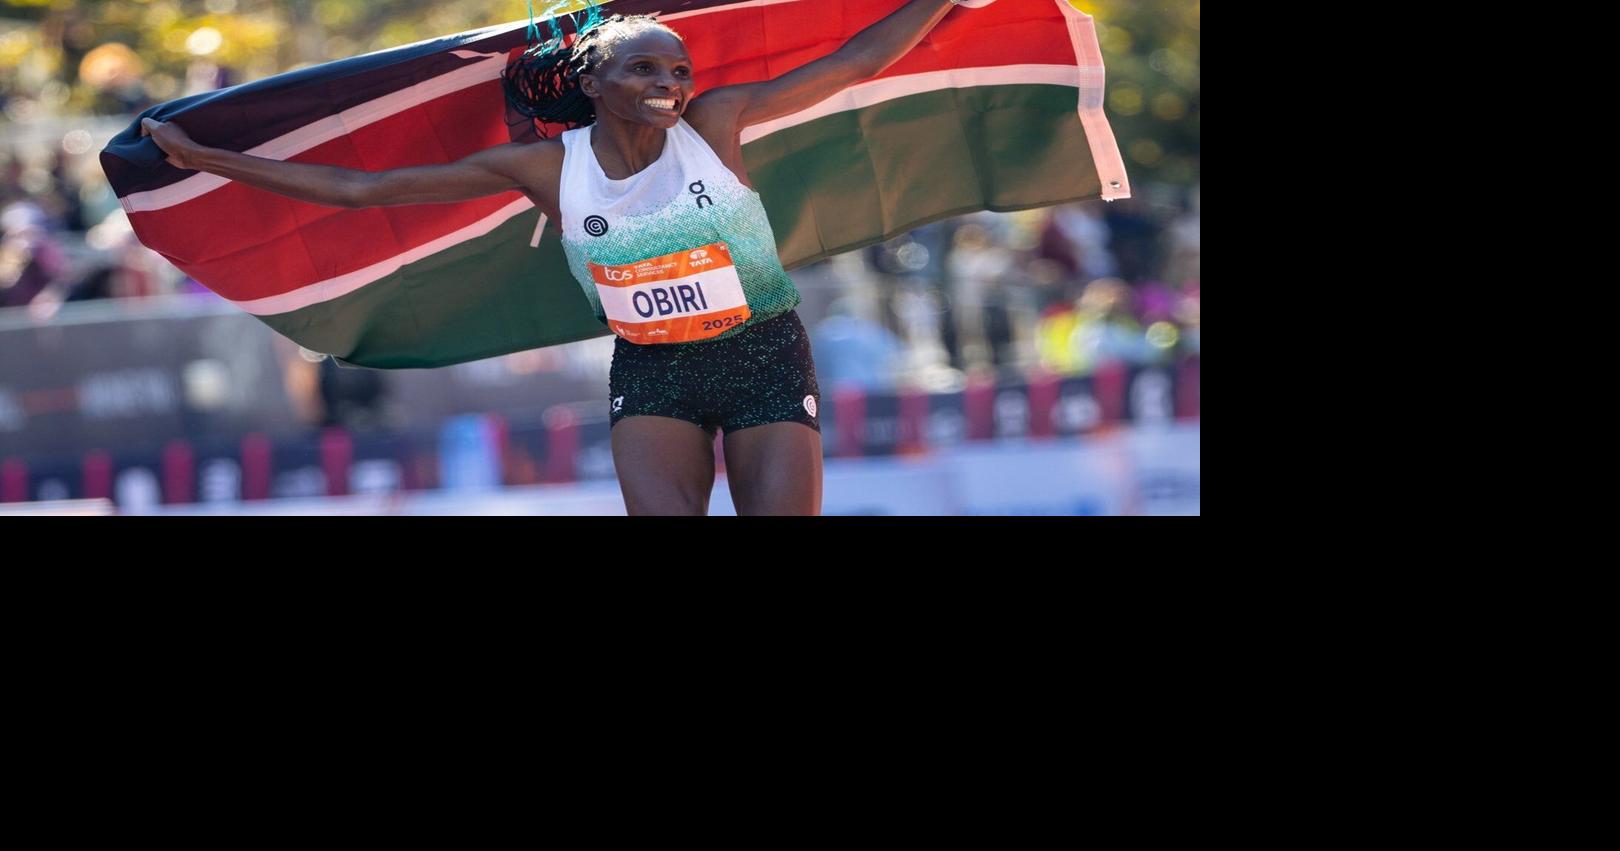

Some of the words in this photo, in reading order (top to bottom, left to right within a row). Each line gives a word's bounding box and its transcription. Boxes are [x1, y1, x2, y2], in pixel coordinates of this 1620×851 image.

[689, 257, 713, 268] TATA
[604, 266, 633, 281] tcs
[632, 281, 708, 318] OBIRI
[702, 314, 743, 330] 2025
